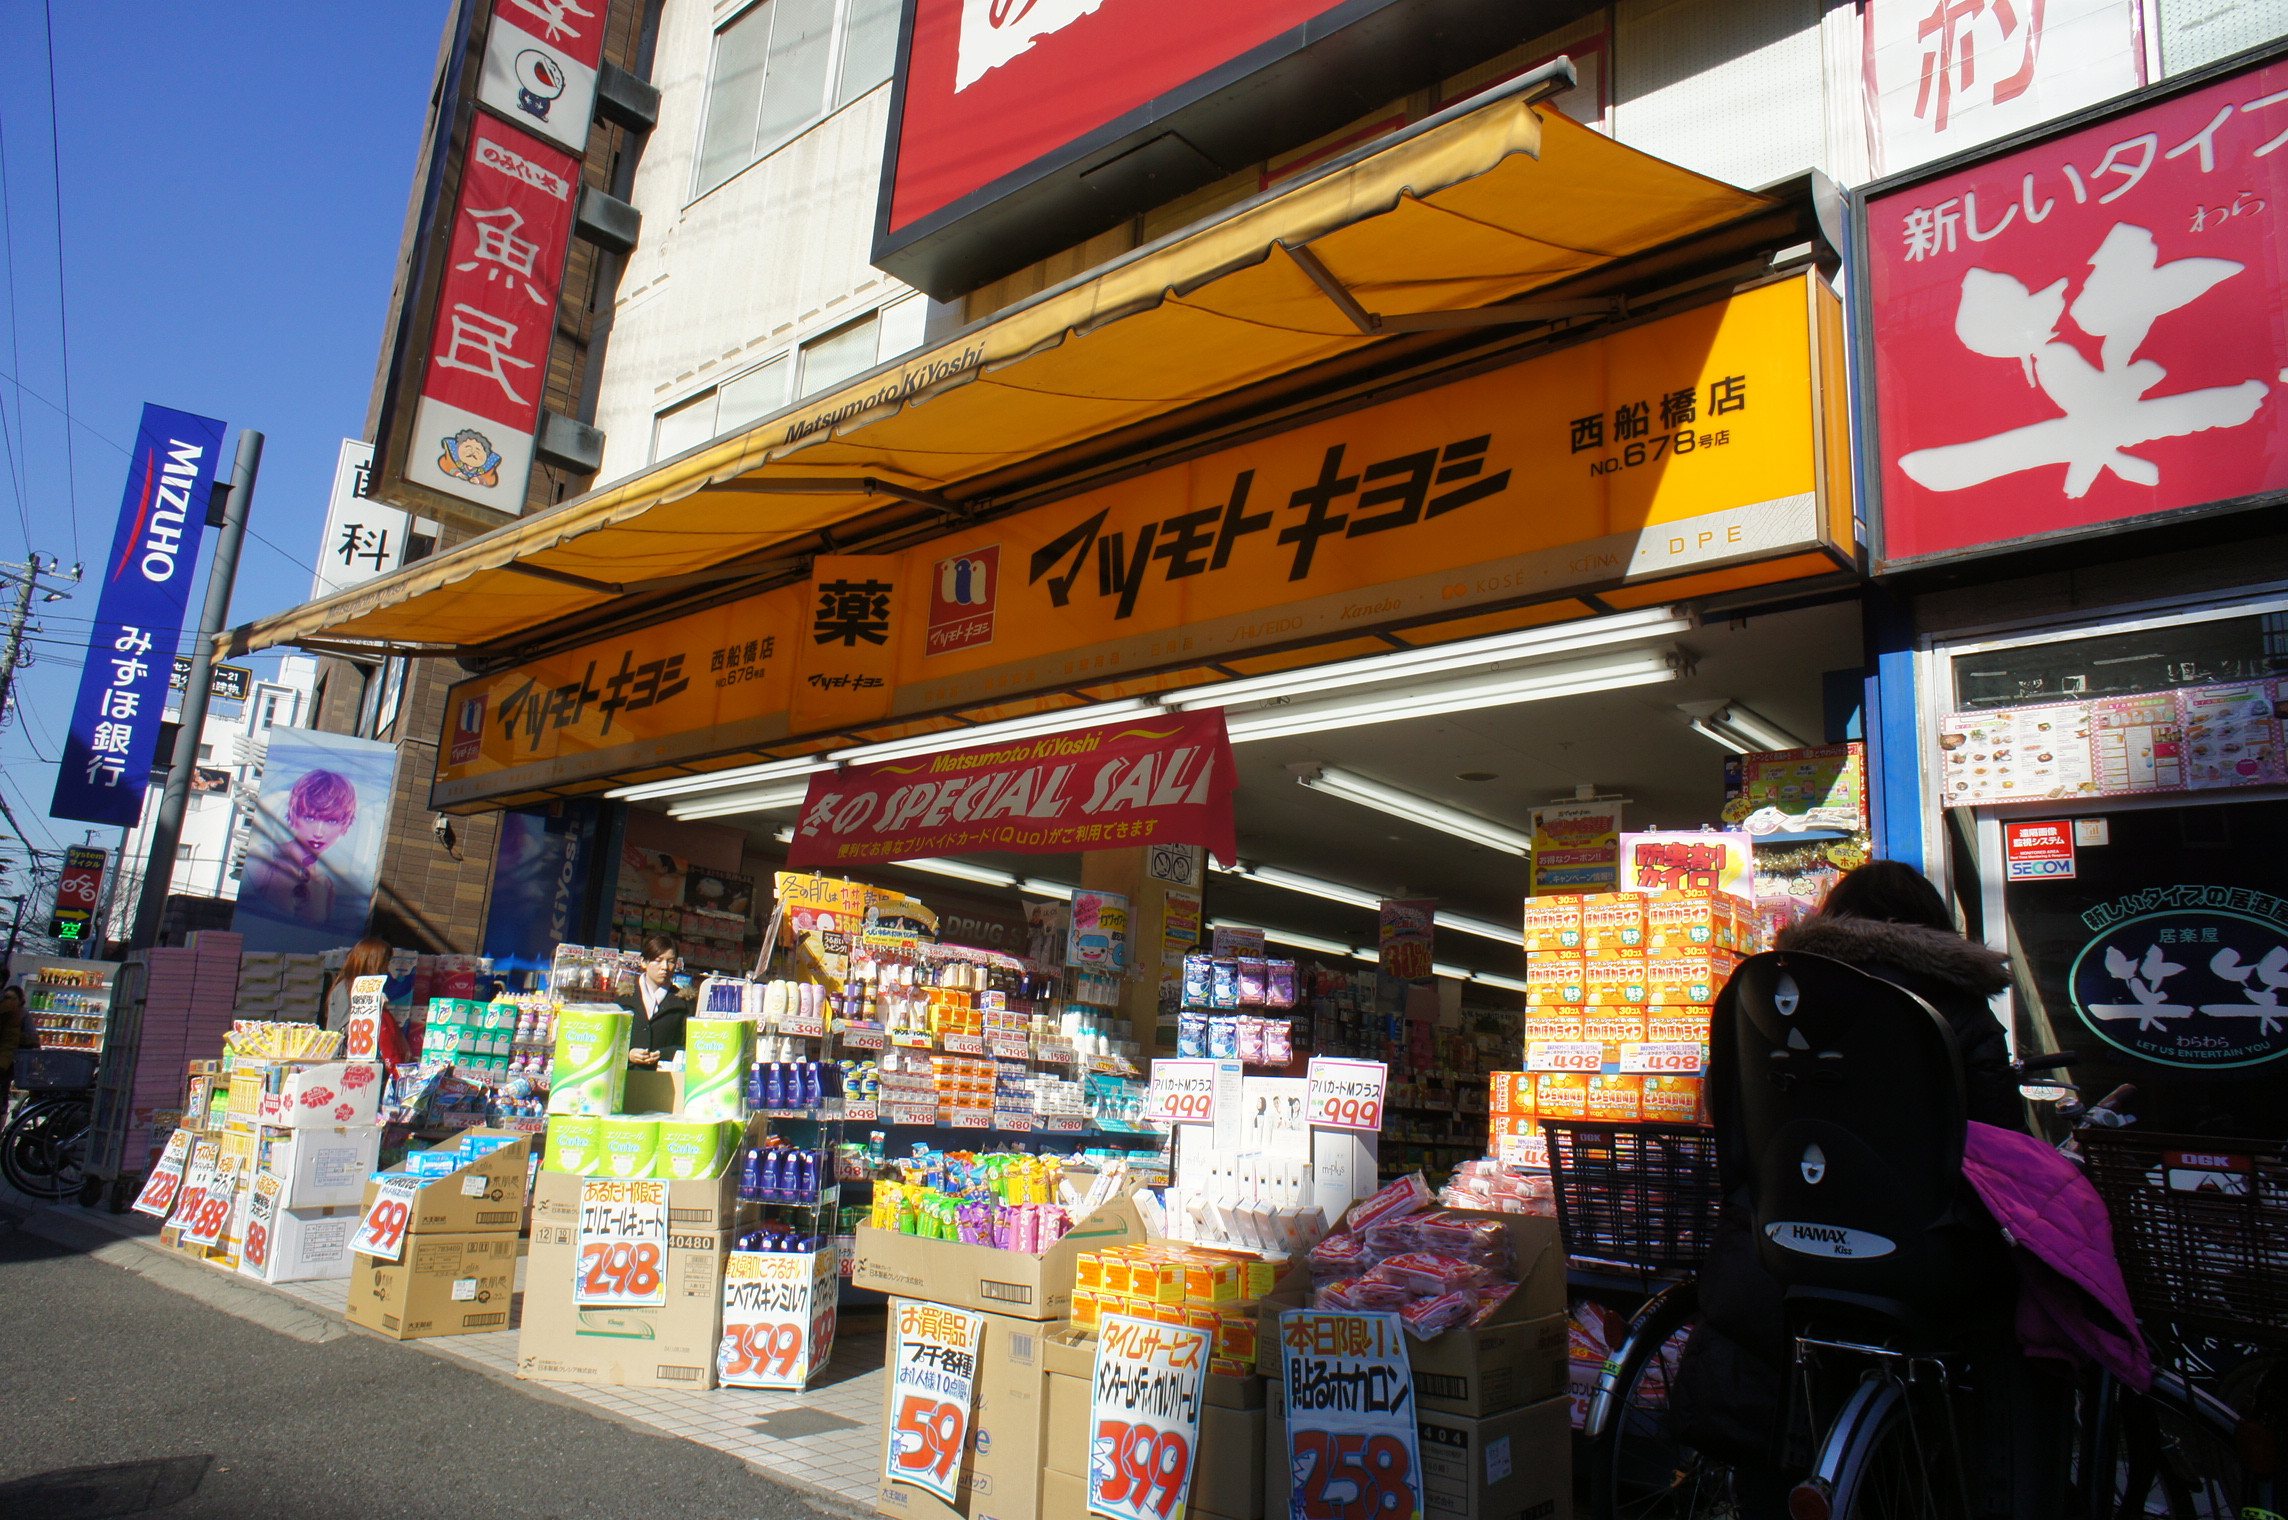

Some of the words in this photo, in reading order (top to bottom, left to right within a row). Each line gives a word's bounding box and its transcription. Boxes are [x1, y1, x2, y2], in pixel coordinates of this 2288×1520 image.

[2189, 190, 2265, 232] わら
[435, 206, 548, 406] 魚民
[784, 383, 899, 445] Matsumoto
[900, 341, 986, 395] KiYoshi
[1569, 373, 1748, 455] 西船橋店
[141, 438, 203, 582] MIZUHO
[1030, 433, 1513, 620] マツモトキヨシ
[1668, 524, 1743, 555] DPE
[812, 578, 894, 647] 薬
[1339, 597, 1402, 622] Kanebo
[929, 620, 991, 648] マツモトキヨシ
[1227, 615, 1303, 644] SHISEIDO
[710, 635, 776, 673] 西船橋店
[173, 662, 239, 681] センー21
[807, 672, 885, 693] マツモトキヨシ
[86, 625, 152, 788] みずほ銀行
[497, 648, 691, 752] マツモトキヨシ
[930, 744, 1032, 773] Matsumoto
[1032, 731, 1104, 760] KiYoshi
[872, 762, 1078, 832] SPECIAL
[2013, 836, 2066, 848] 監視システム
[69, 849, 105, 861] System
[1635, 842, 1726, 870] 防虫剤
[2012, 860, 2070, 875] SECOM
[1637, 866, 1719, 891] カイロ
[1525, 913, 1580, 929] ぽかぽかライフ
[1585, 911, 1641, 928] ぽかぽかライフ
[1649, 907, 1709, 925] ぽかぽかライフ
[944, 915, 1005, 943] DRUG
[2159, 928, 2219, 943] 居楽屋
[1528, 967, 1583, 984] ぽかぽかライフ
[1586, 966, 1645, 983] ぽかぽかライフ
[1649, 965, 1709, 982] ぽかぽかライフ
[563, 1021, 603, 1032] エリエール
[691, 1031, 729, 1040] エリエール
[795, 1023, 822, 1035] 399
[350, 1018, 374, 1055] 88
[566, 1031, 598, 1042] Cute
[694, 1040, 725, 1051] Cute
[858, 1037, 883, 1048] 698
[2176, 1035, 2230, 1048] わらわら
[958, 1043, 982, 1053] 498
[1005, 1047, 1027, 1058] 798
[1050, 1052, 1071, 1062] 1580
[2136, 1039, 2157, 1050] LET
[2159, 1046, 2174, 1056] US
[2178, 1045, 2244, 1058] ENTERTAIN
[2245, 1041, 2271, 1055] YOU
[1553, 1055, 1600, 1068] 498
[1648, 1055, 1699, 1070] 498
[849, 1109, 875, 1119] 698
[1164, 1094, 1212, 1117] 999
[1323, 1097, 1379, 1126] 999
[909, 1113, 933, 1123] 798
[966, 1117, 988, 1127] 798
[1008, 1119, 1030, 1130] 980
[1060, 1119, 1081, 1130] 980
[554, 1125, 594, 1135] エリエール
[605, 1131, 646, 1141] エリエール
[664, 1132, 706, 1142] エリエール
[557, 1134, 590, 1146] Cute
[608, 1140, 640, 1153] Cute
[667, 1142, 701, 1155] Cute
[2182, 1153, 2229, 1167] OGK
[584, 1182, 663, 1205] あるだけ限定
[191, 1199, 228, 1238] 88
[368, 1199, 408, 1251] 99
[583, 1206, 664, 1237] エリエールキュート
[539, 1229, 550, 1239] 12
[1793, 1225, 1848, 1244] HAMAX
[246, 1221, 266, 1267] 88
[1834, 1245, 1852, 1255] Kiss
[581, 1242, 660, 1297] 298
[900, 1305, 978, 1348] お買得品!
[724, 1322, 803, 1378] 399
[1102, 1321, 1203, 1371] タイムサービス
[903, 1341, 975, 1380] プチ各種
[1291, 1357, 1409, 1415] 貼るホカロン
[894, 1394, 964, 1485] 59
[1093, 1420, 1189, 1520] 399
[1293, 1430, 1417, 1520] 258
